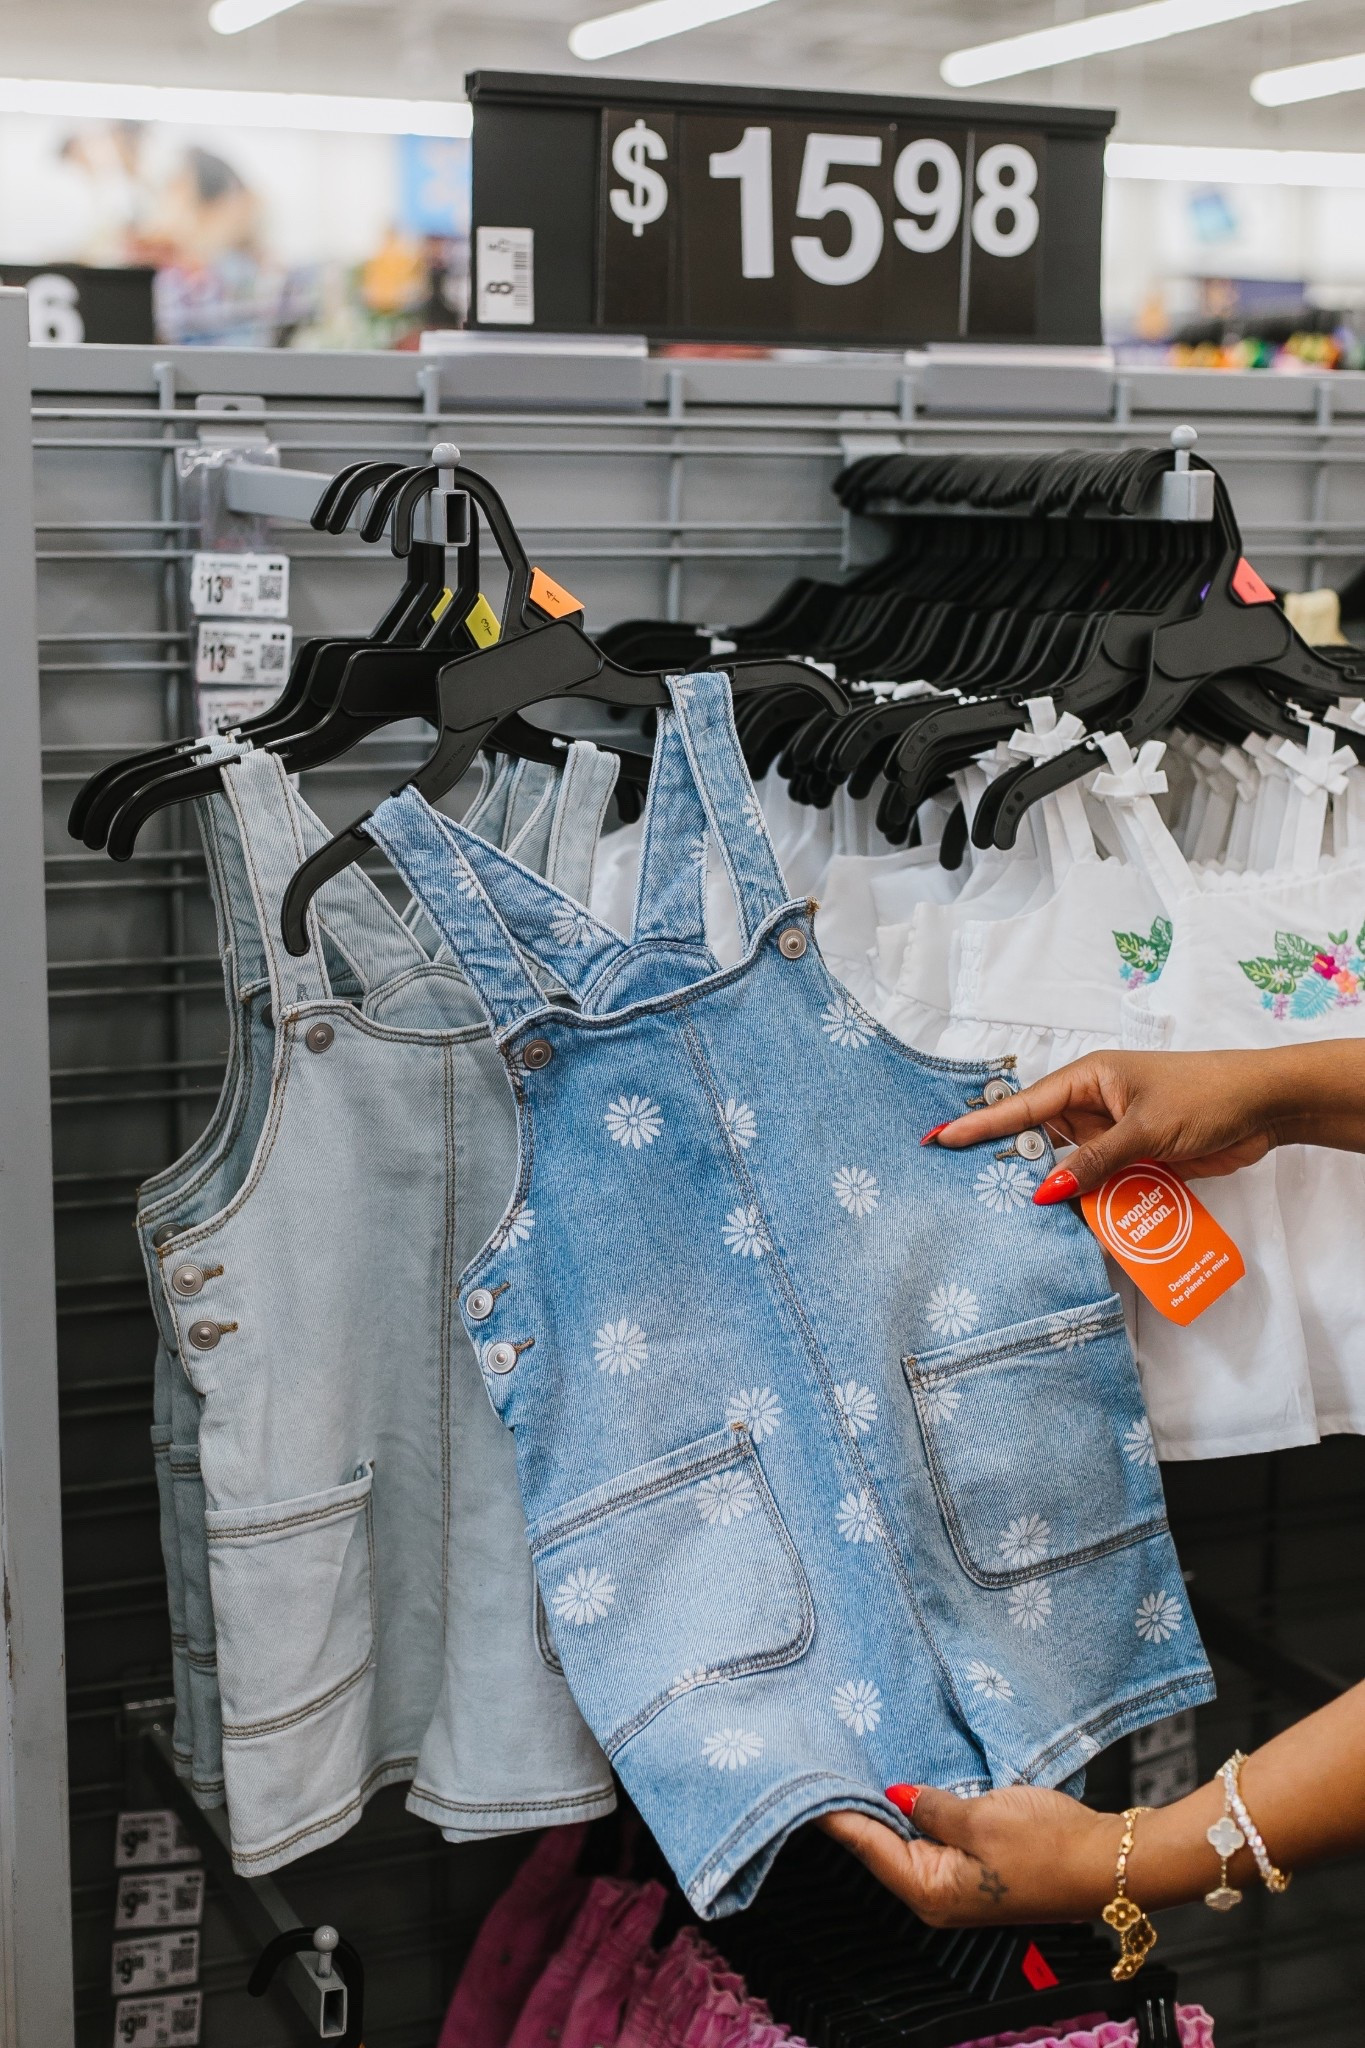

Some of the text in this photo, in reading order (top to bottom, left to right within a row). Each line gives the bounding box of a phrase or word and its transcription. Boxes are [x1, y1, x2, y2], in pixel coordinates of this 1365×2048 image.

[1116, 1186, 1163, 1230] wonder
[1168, 1250, 1216, 1293] Designed with
[1170, 1253, 1230, 1307] the planet in mind
